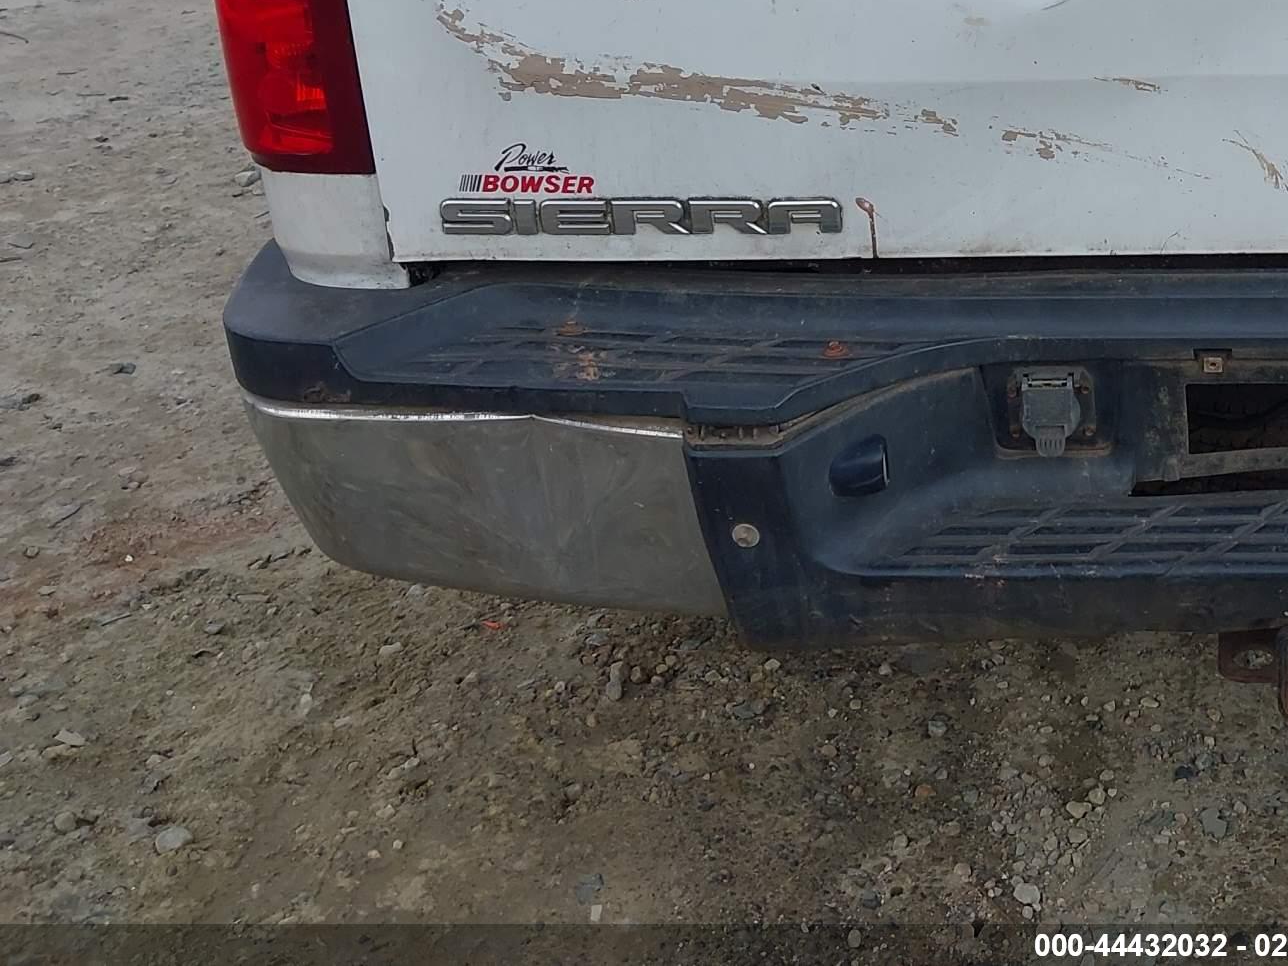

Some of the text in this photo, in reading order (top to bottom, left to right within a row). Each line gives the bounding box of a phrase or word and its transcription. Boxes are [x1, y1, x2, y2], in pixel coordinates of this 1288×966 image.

[494, 143, 557, 172] Power
[482, 174, 595, 194] BOWSER
[439, 197, 844, 236] SIERRA
